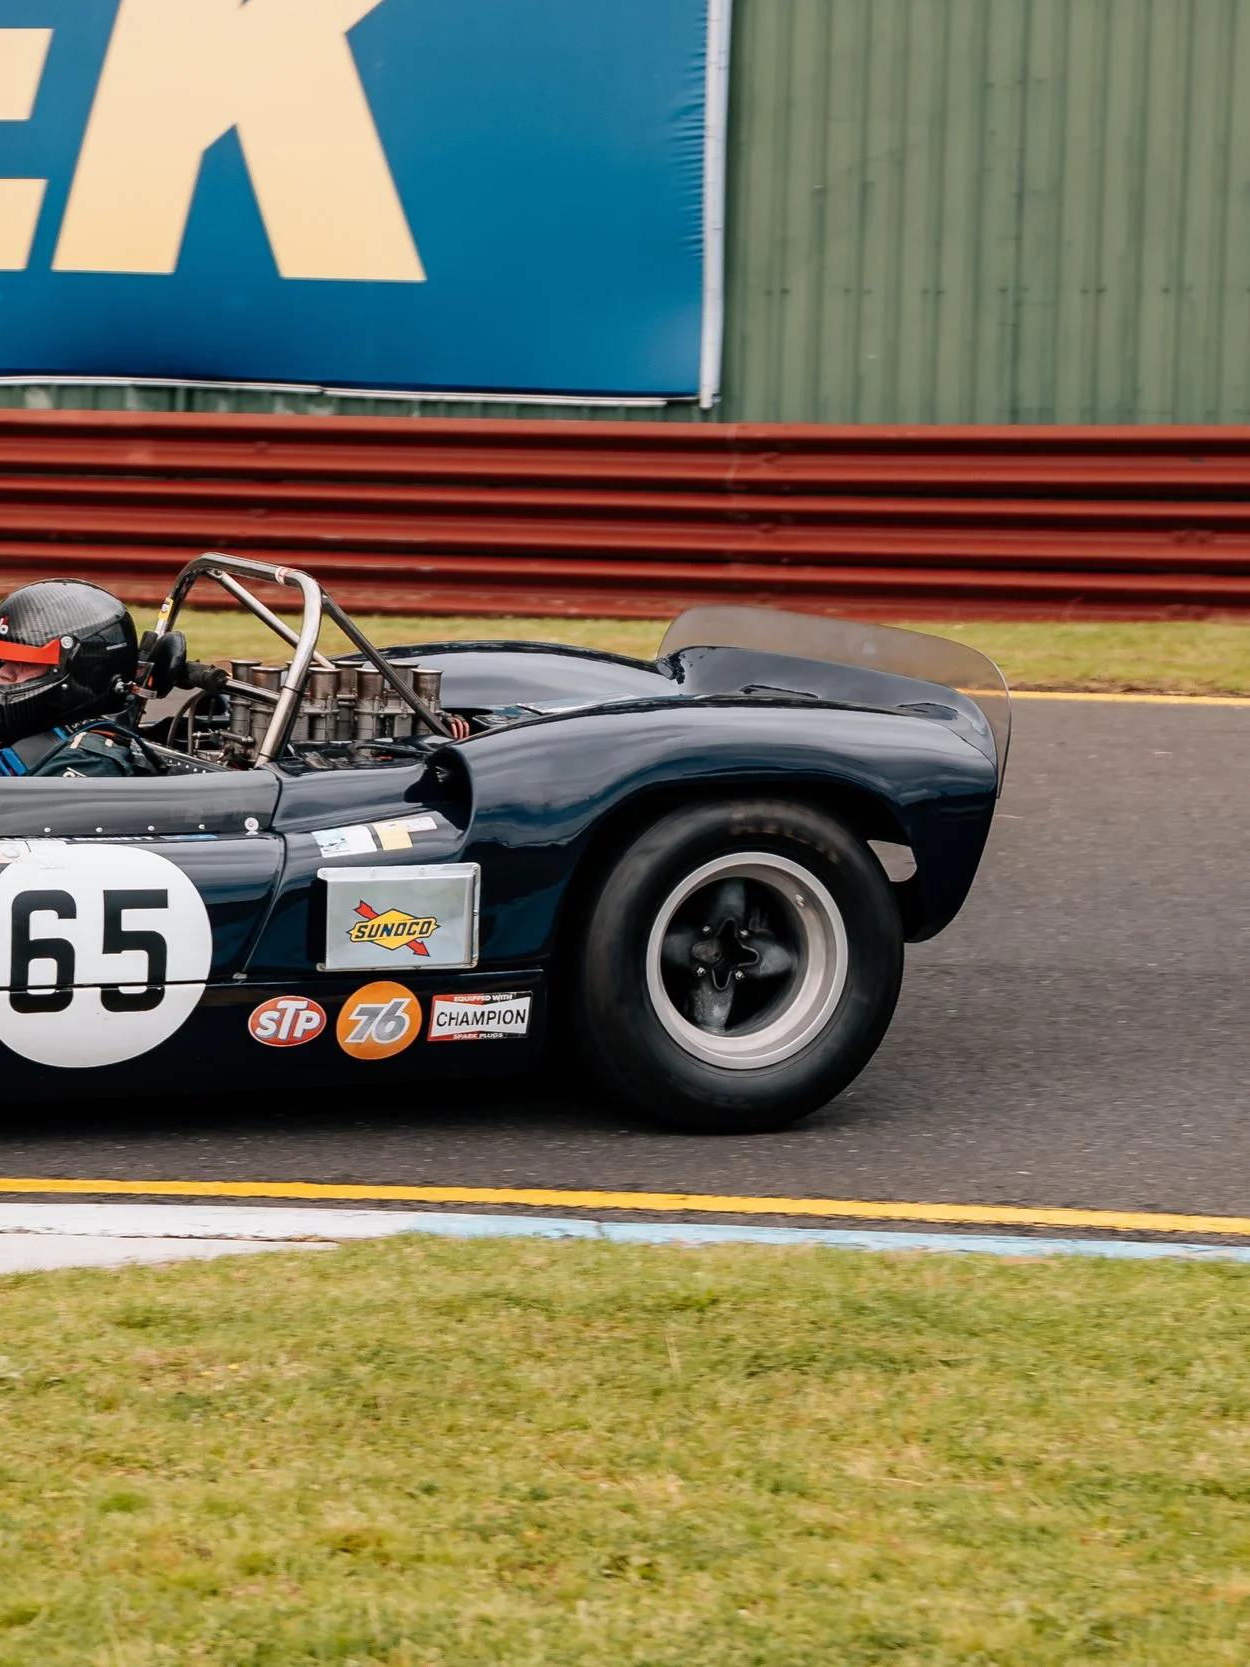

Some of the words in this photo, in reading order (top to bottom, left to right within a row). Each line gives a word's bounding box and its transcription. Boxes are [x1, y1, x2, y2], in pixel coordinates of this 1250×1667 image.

[354, 920, 432, 939] SUNOCO
[9, 889, 168, 1013] 65
[454, 995, 491, 1003] EQUIPPED
[255, 1001, 321, 1041] STP
[345, 998, 412, 1044] 76
[436, 1009, 526, 1027] CHAMPION
